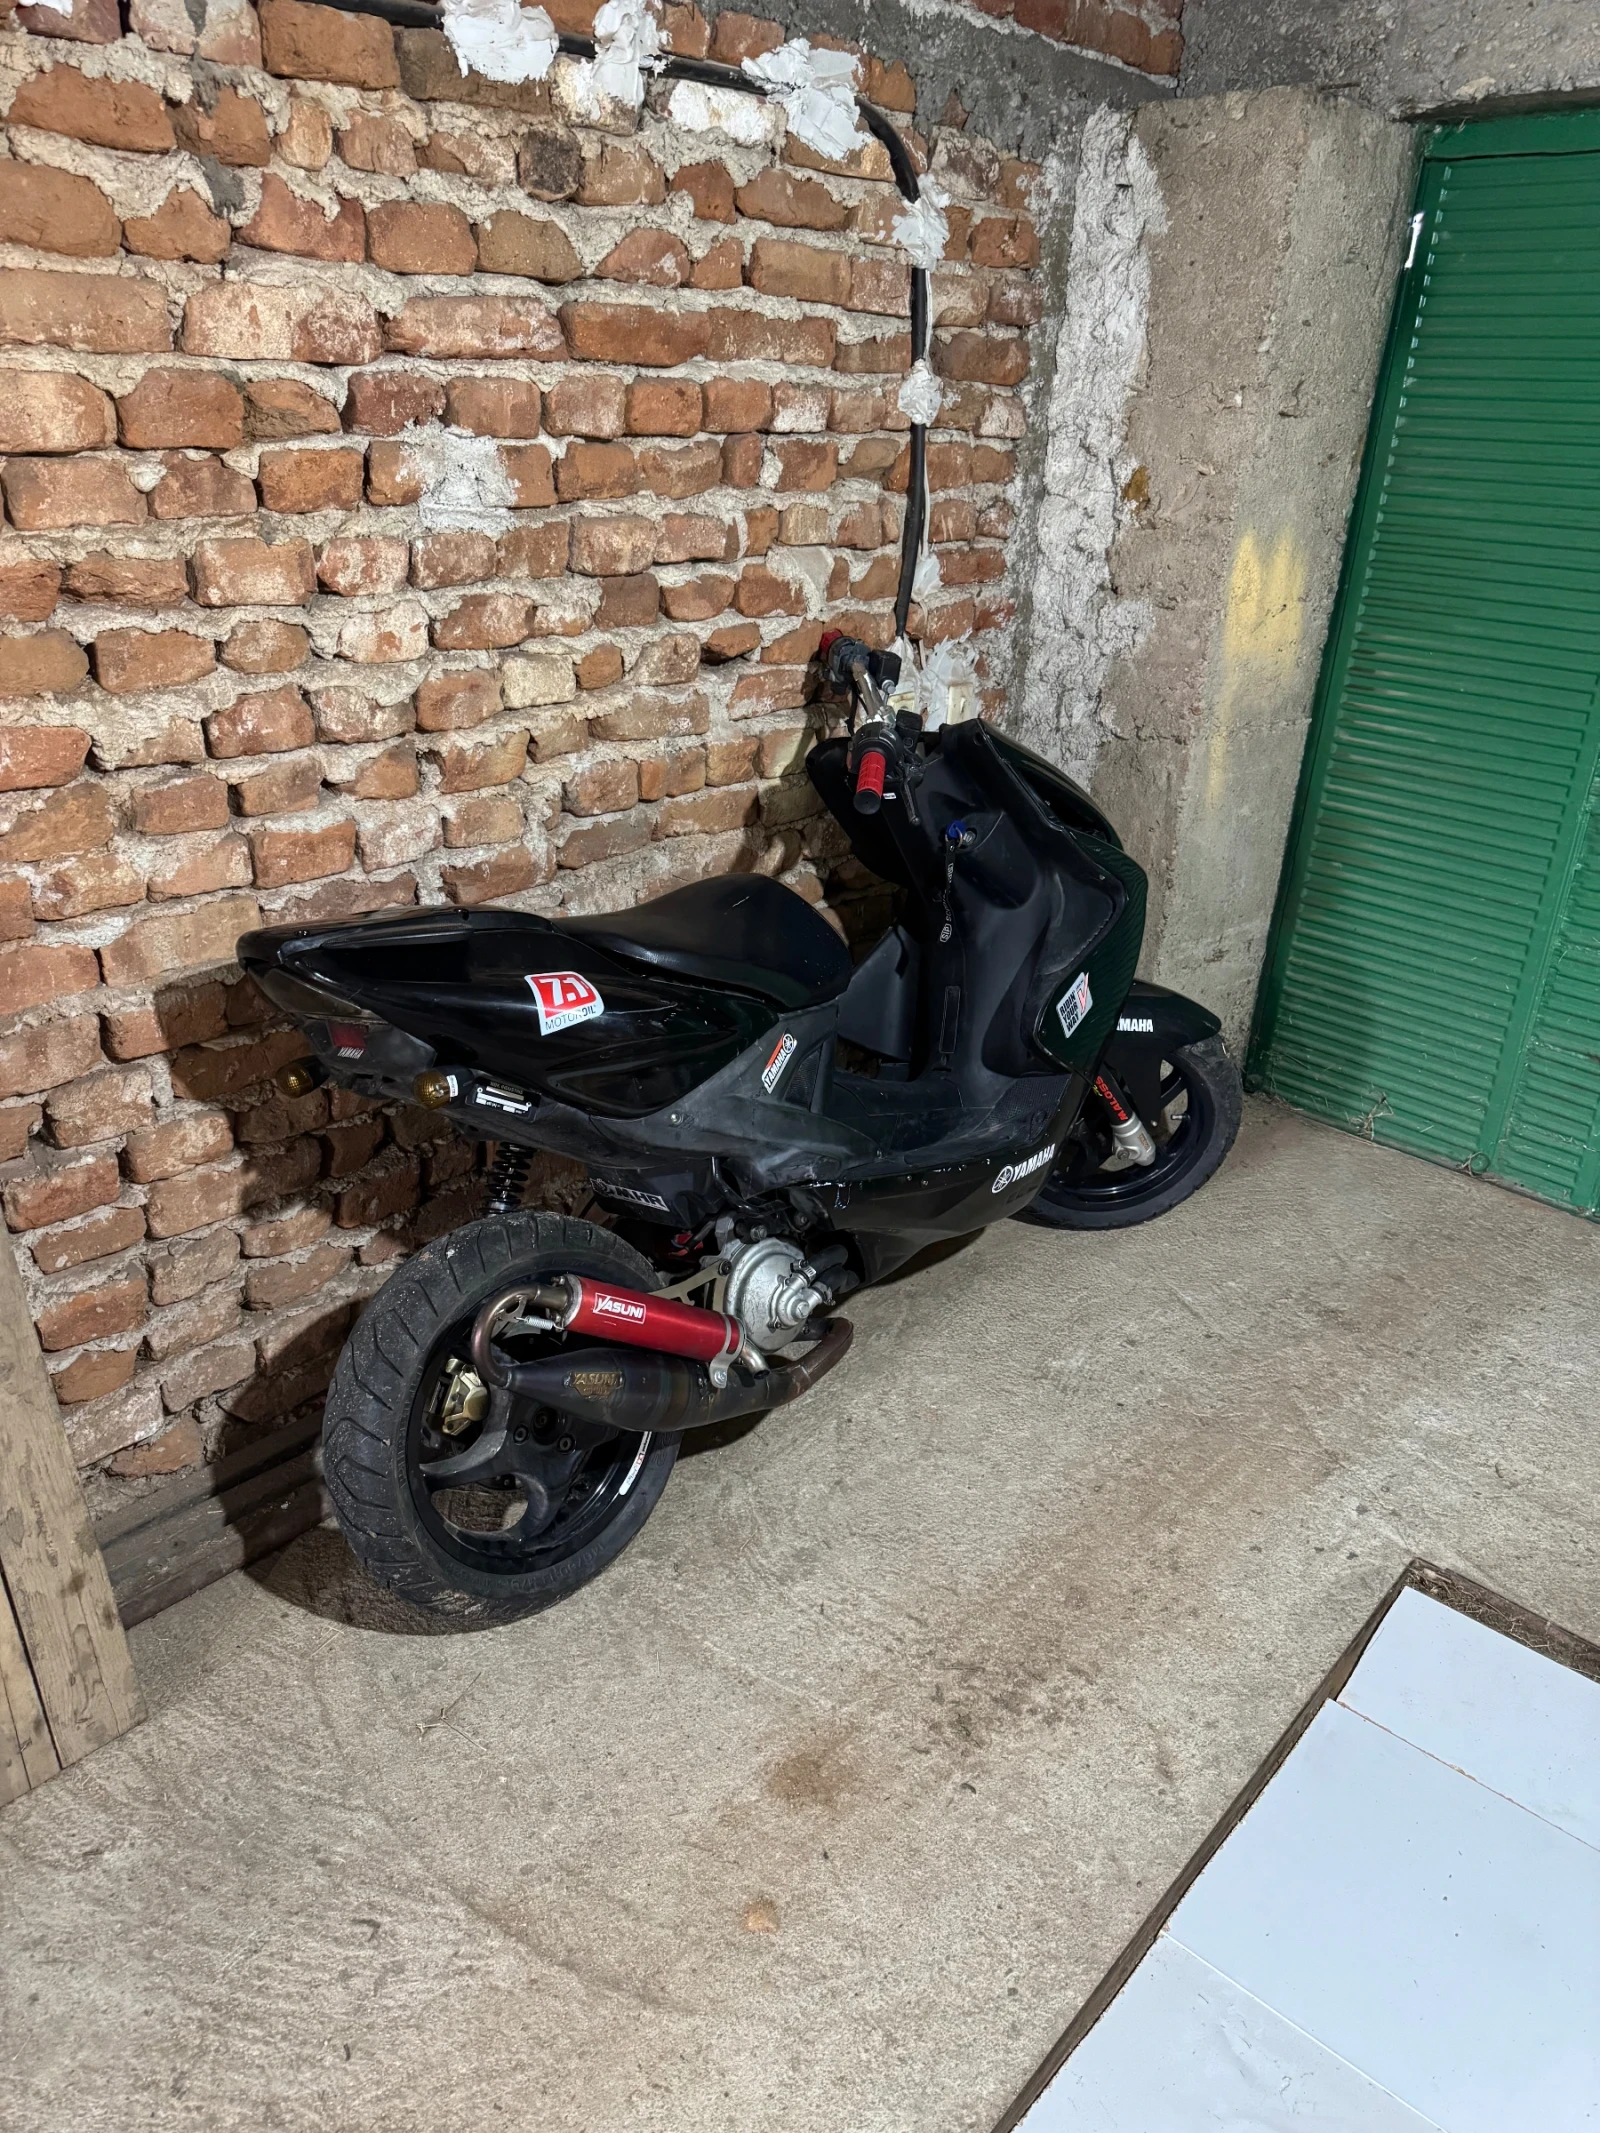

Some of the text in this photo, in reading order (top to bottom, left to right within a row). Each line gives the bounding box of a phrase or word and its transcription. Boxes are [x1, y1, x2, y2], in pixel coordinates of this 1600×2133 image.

[1063, 1002, 1079, 1024] YOUR
[1066, 1013, 1080, 1032] WAY
[337, 1047, 365, 1060] YAMAHA
[763, 1048, 788, 1087] YAMAHA
[1011, 1143, 1056, 1183] YAMAHA
[593, 1295, 644, 1319] YASUNI
